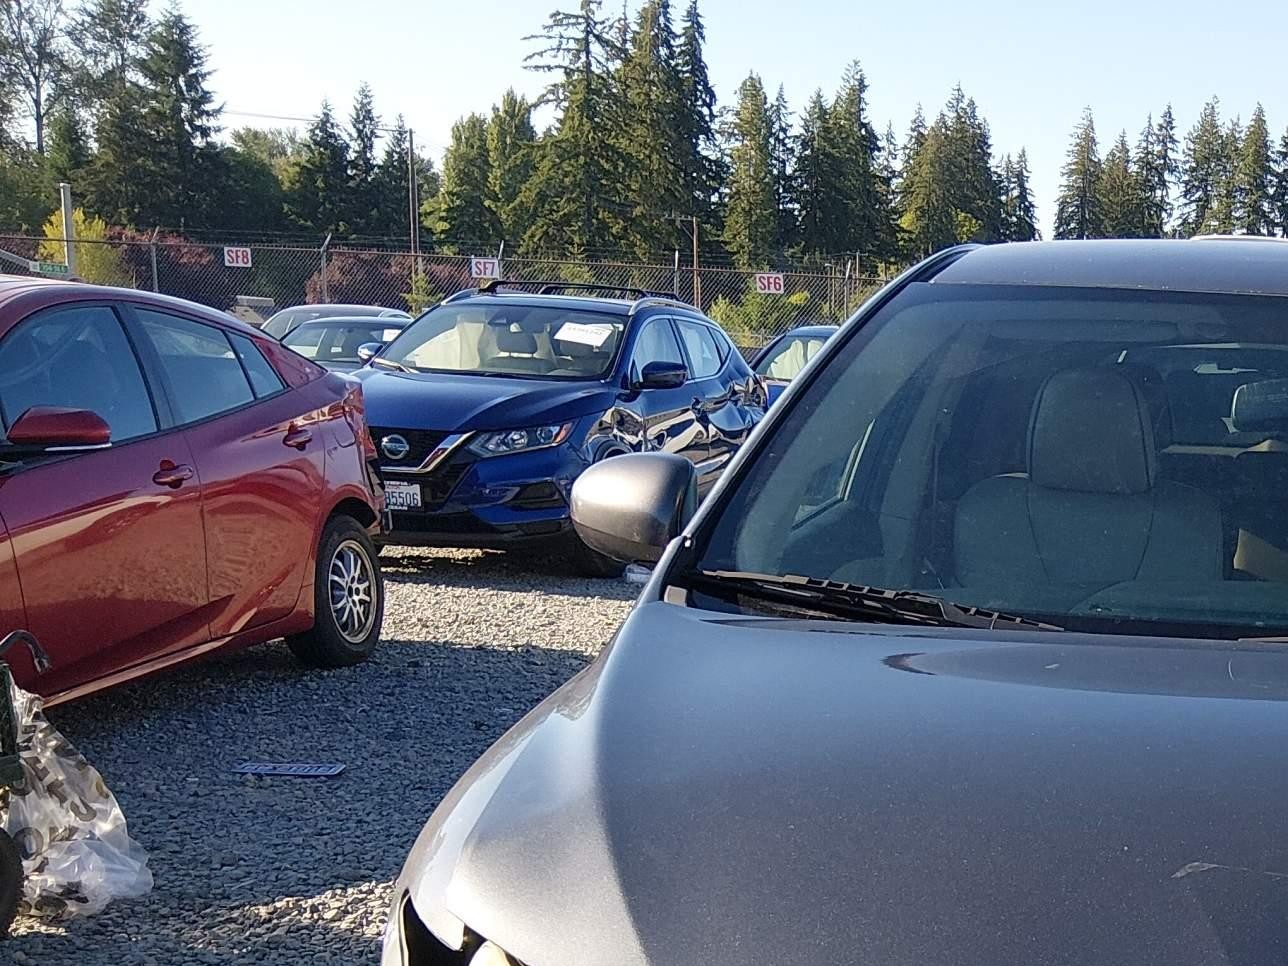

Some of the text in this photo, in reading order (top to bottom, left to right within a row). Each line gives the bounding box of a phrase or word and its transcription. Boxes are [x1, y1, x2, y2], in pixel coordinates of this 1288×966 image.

[226, 249, 250, 265] SF8
[474, 261, 496, 276] SF7
[758, 275, 782, 291] SF6
